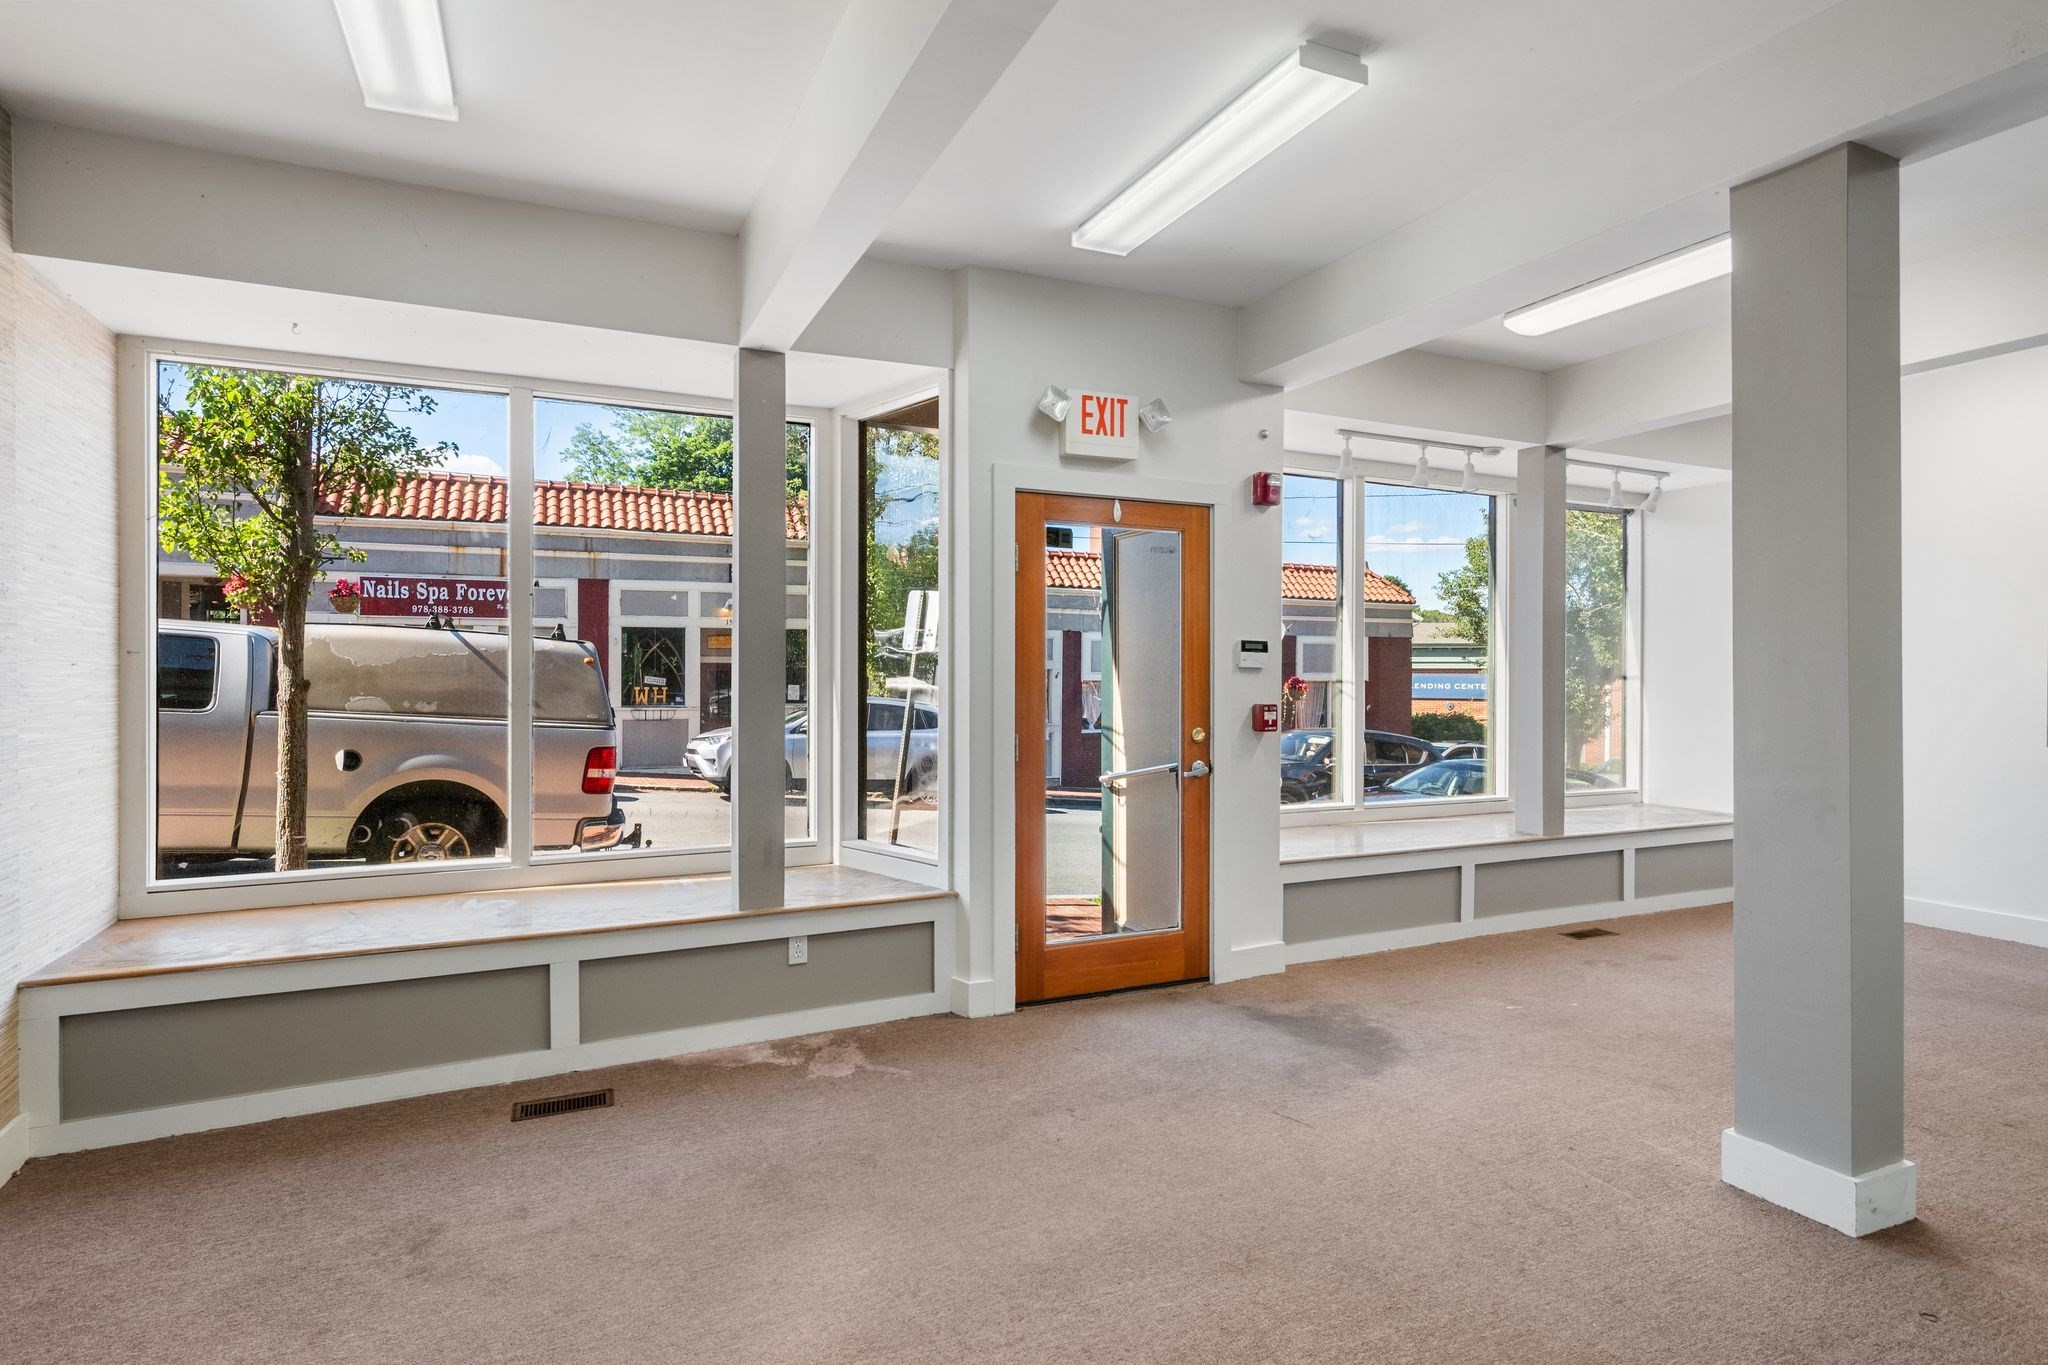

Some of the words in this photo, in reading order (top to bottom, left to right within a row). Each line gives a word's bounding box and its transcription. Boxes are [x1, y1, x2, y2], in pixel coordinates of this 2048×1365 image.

[1081, 394, 1128, 438] EXIT
[362, 579, 410, 600] Nails
[416, 581, 450, 604] Spa
[455, 583, 511, 601] Forev
